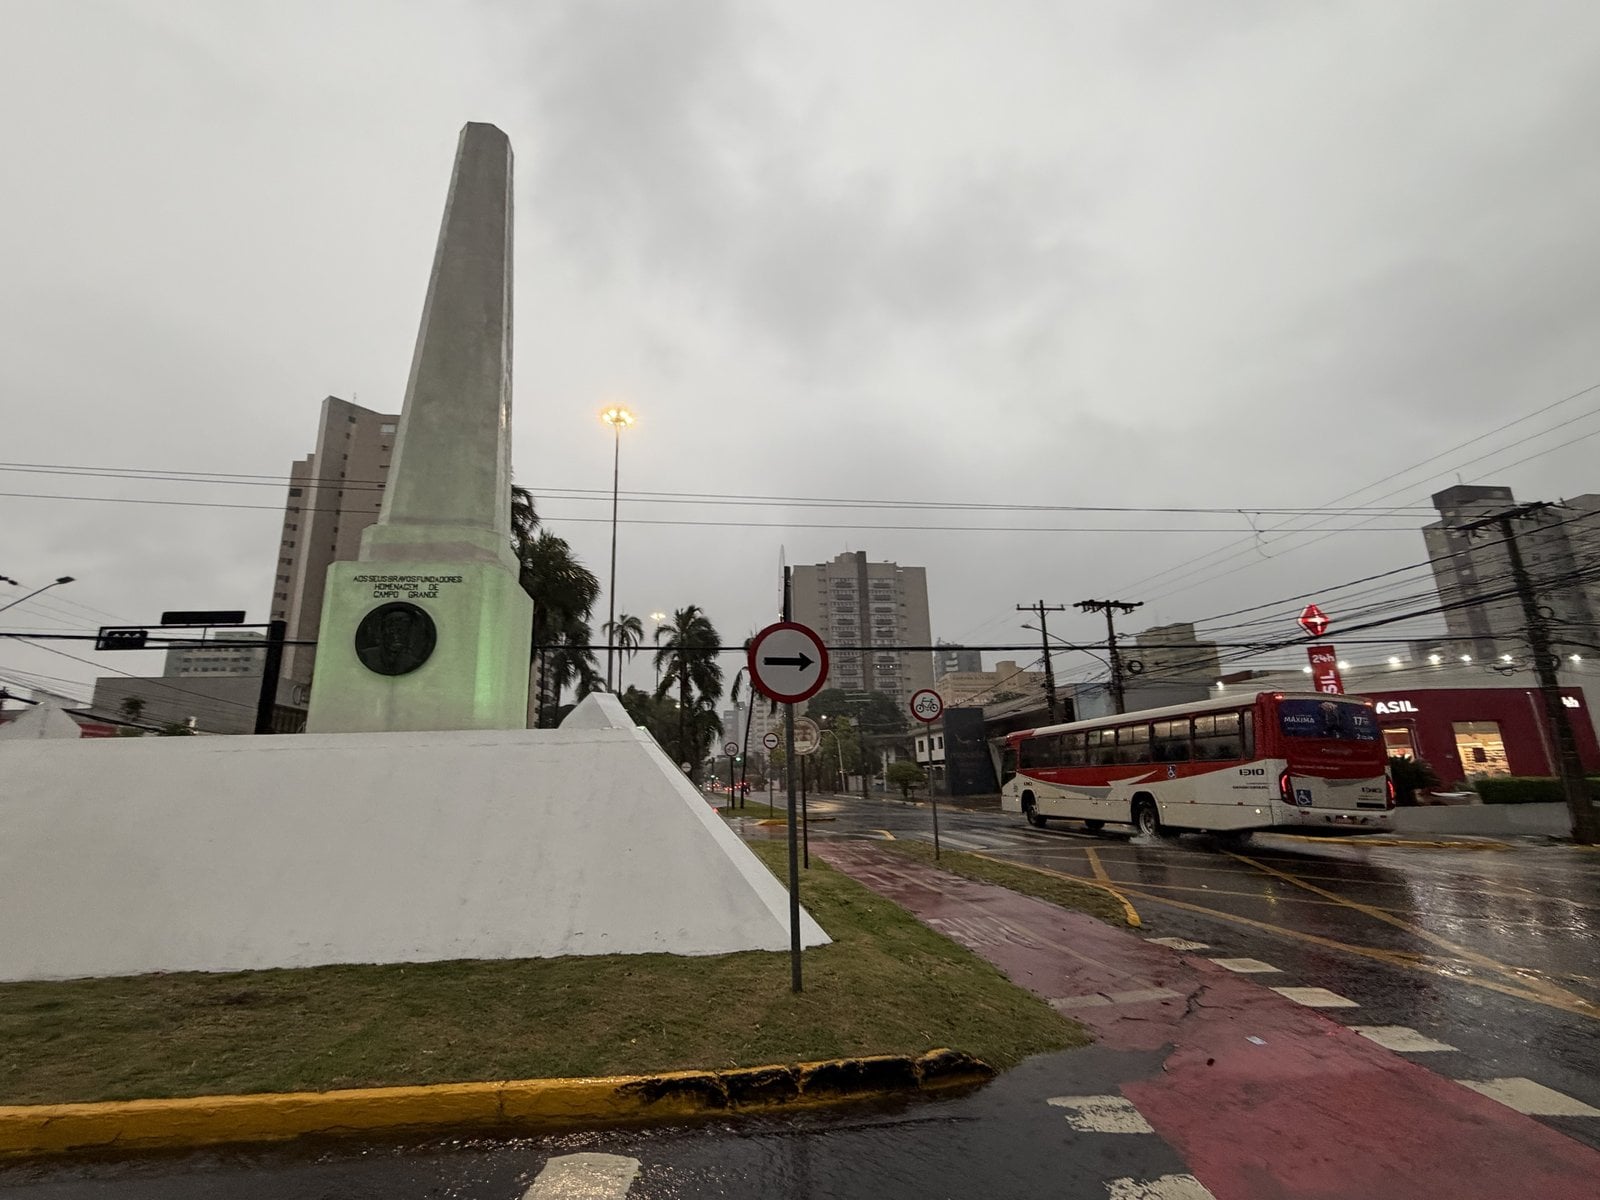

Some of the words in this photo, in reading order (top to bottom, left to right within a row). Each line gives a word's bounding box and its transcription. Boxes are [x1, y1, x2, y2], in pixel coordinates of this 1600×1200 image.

[417, 575, 462, 583] FUNDADORES
[1312, 653, 1335, 663] 24h
[1320, 670, 1338, 693] SIL
[1376, 700, 1419, 714] ASIL
